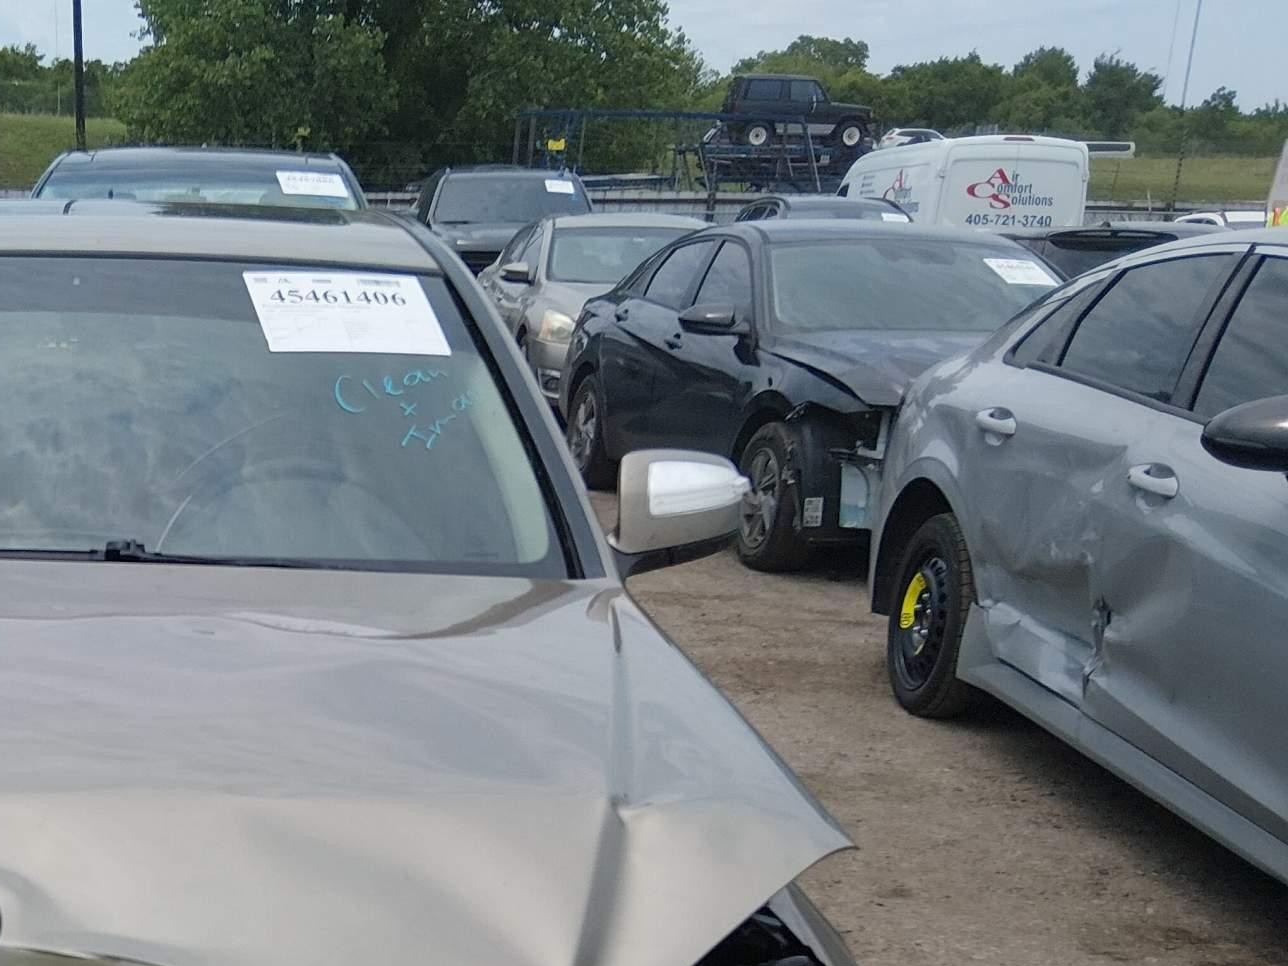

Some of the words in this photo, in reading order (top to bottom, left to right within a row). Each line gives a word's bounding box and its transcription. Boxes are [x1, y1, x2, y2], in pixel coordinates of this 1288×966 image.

[986, 168, 1020, 185] Air
[966, 182, 1033, 199] Comfort
[989, 193, 1054, 209] Solutions
[965, 213, 1053, 227] 405-721-3740
[269, 288, 408, 307] 45461406
